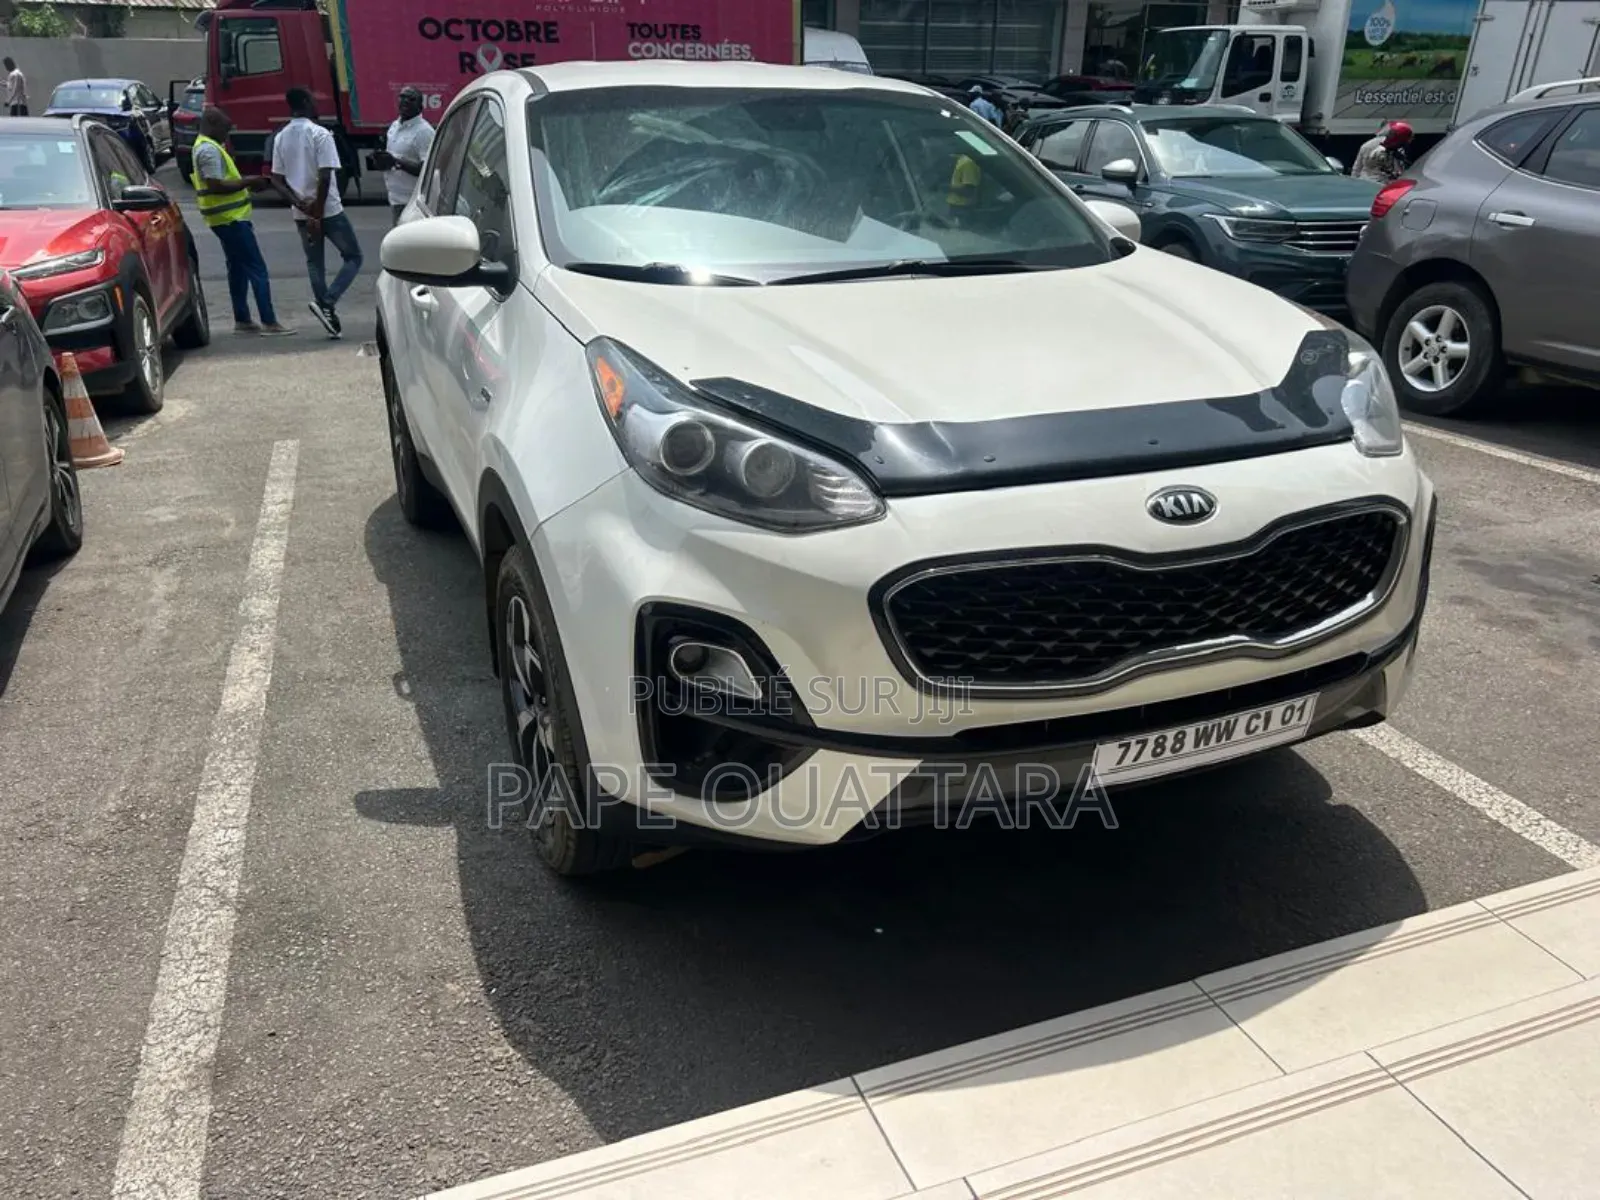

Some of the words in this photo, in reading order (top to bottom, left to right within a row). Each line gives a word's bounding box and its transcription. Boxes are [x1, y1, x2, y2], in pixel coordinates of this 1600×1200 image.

[417, 16, 561, 44] OCTOBRE
[625, 21, 702, 41] TOUTES
[1356, 89, 1423, 104] L'essentiel
[1425, 90, 1445, 104] est
[1157, 493, 1210, 518] KIA
[1115, 729, 1188, 766] 7788
[1193, 716, 1239, 749] WW
[1281, 699, 1308, 726] 01
